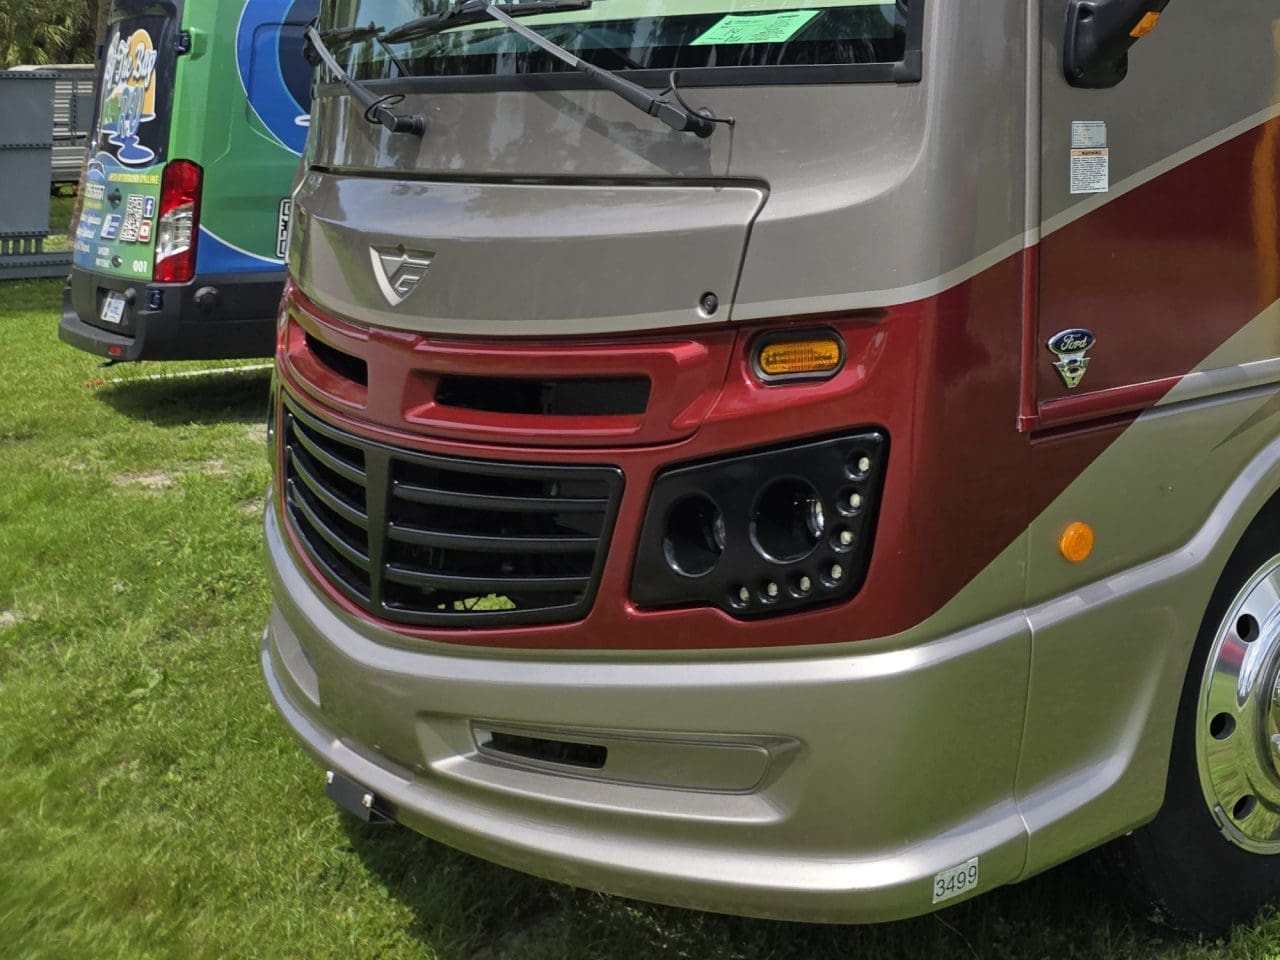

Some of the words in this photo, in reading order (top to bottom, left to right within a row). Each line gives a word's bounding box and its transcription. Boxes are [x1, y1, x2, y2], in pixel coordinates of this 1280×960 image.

[132, 260, 148, 273] 001
[1060, 333, 1088, 351] Ford
[935, 865, 977, 897] 3499
